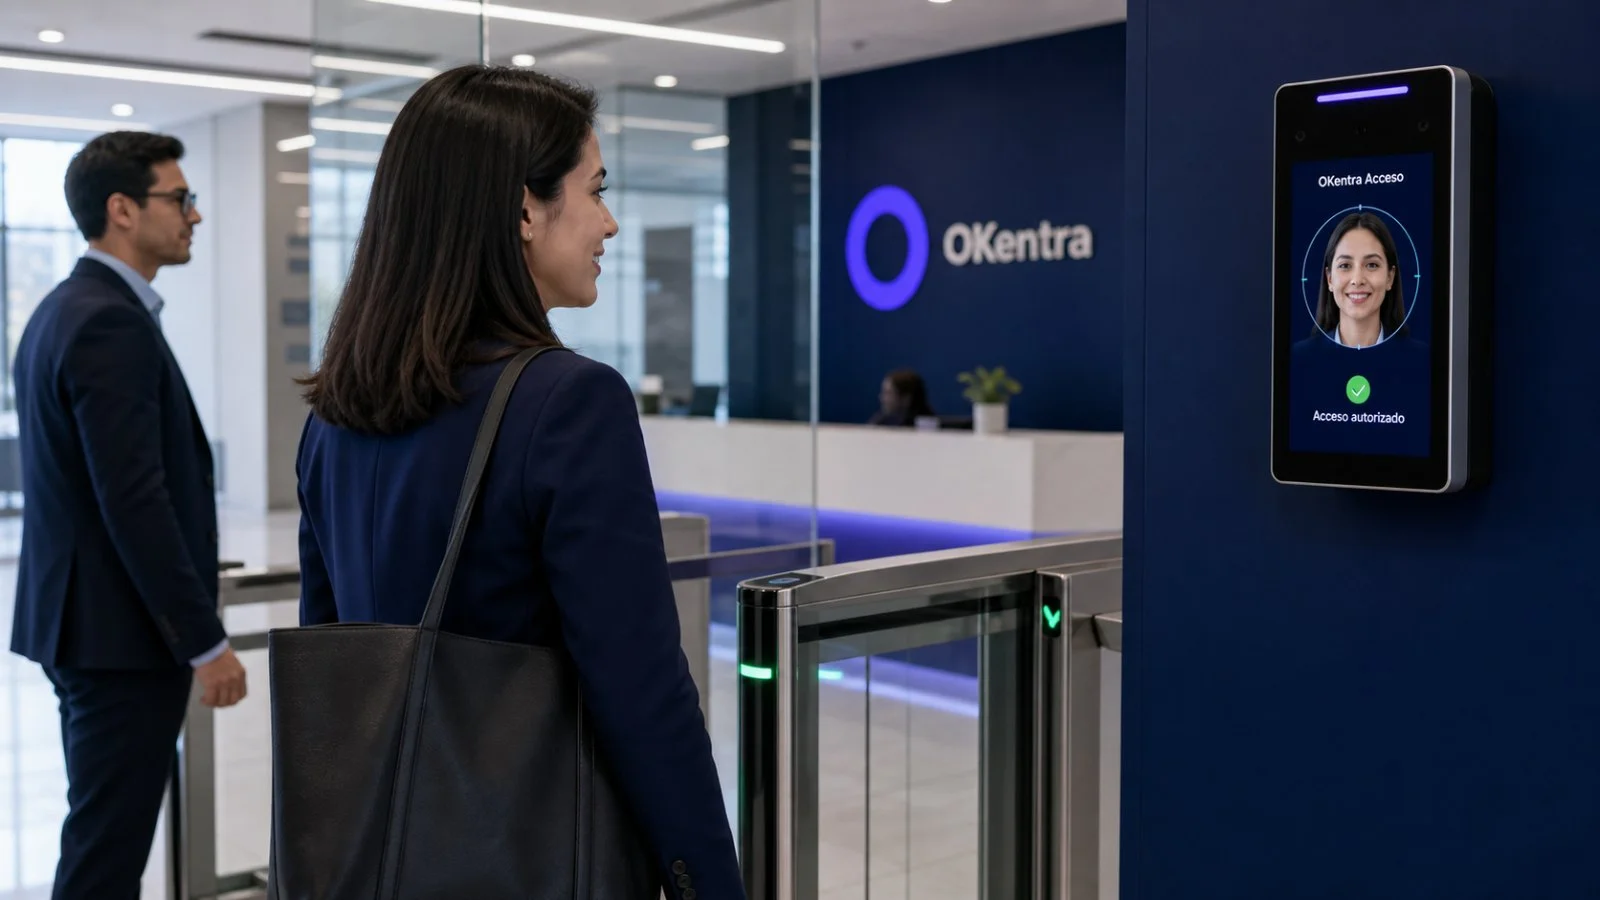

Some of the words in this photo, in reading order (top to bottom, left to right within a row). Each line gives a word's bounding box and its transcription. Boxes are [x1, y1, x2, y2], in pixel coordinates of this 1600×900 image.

[1318, 175, 1362, 187] OKentra
[1364, 173, 1404, 184] Acceso
[943, 220, 1093, 266] OKentra
[1313, 410, 1348, 421] Acceso
[1351, 412, 1405, 423] autorizado
